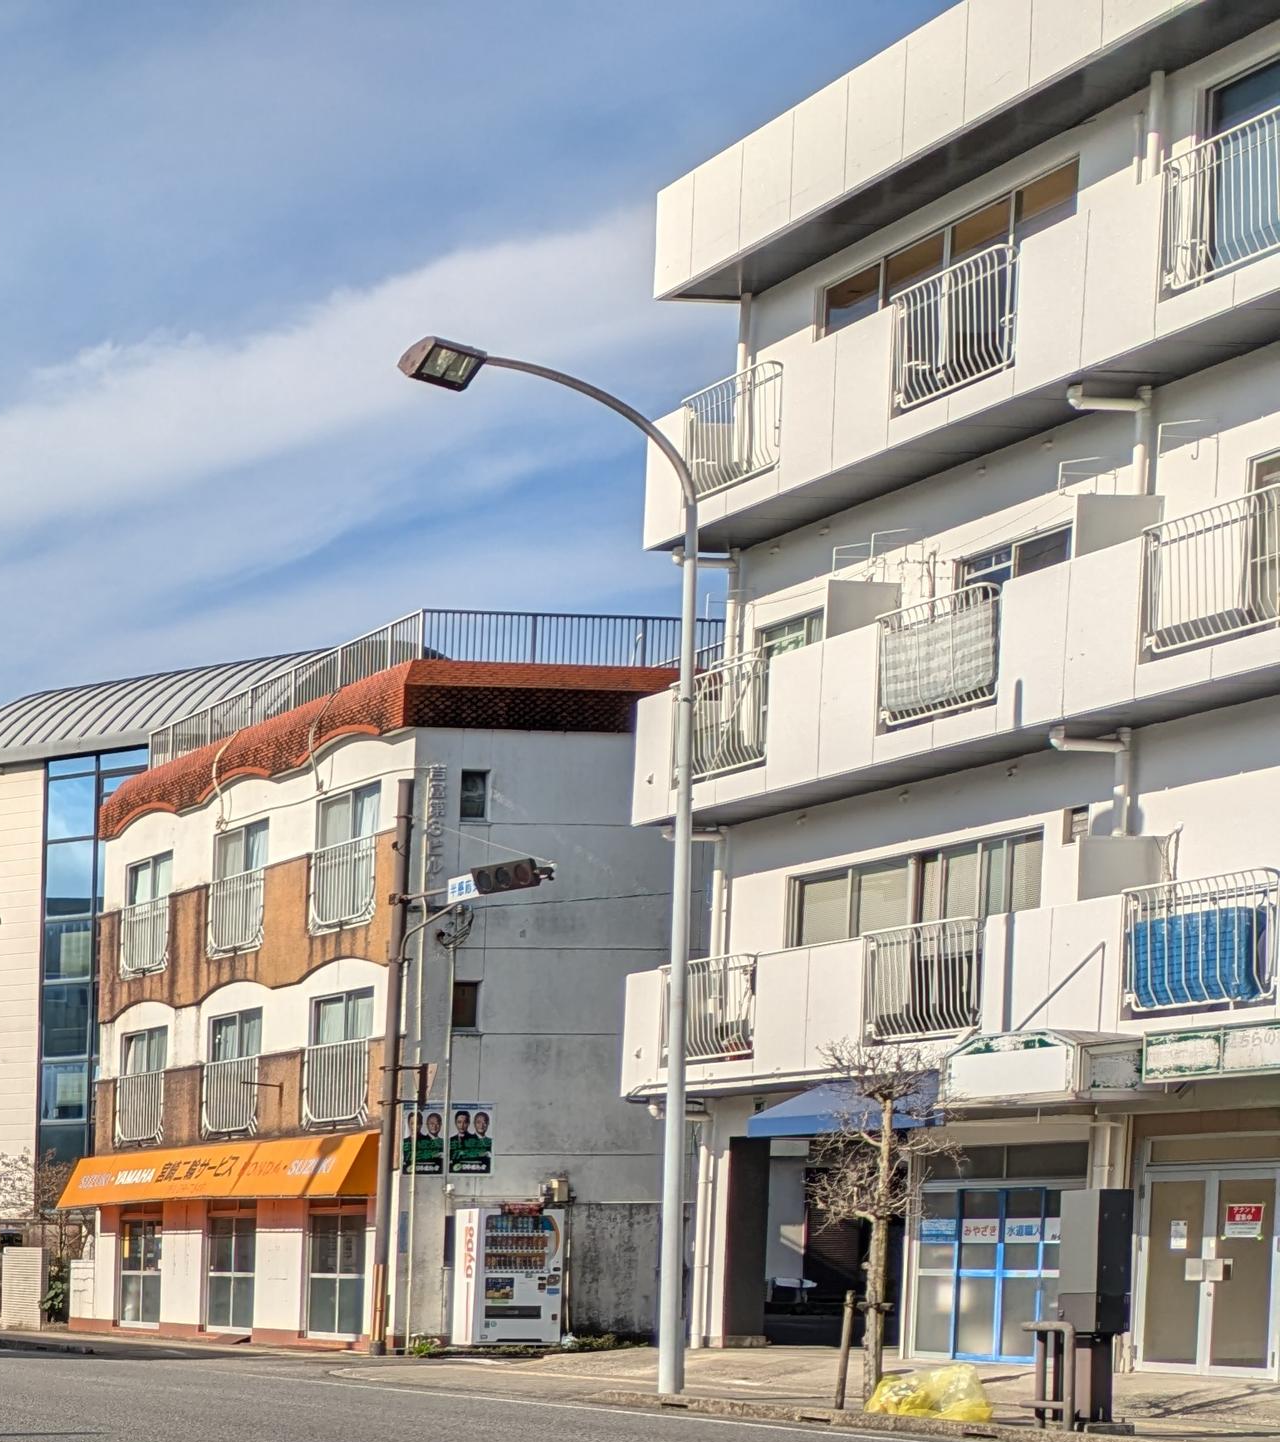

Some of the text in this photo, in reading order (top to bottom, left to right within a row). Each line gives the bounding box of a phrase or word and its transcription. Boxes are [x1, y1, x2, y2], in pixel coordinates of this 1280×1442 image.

[114, 1168, 156, 1185] YAMAHA
[287, 1157, 336, 1176] SUZUKI
[963, 1224, 997, 1237] みやざき
